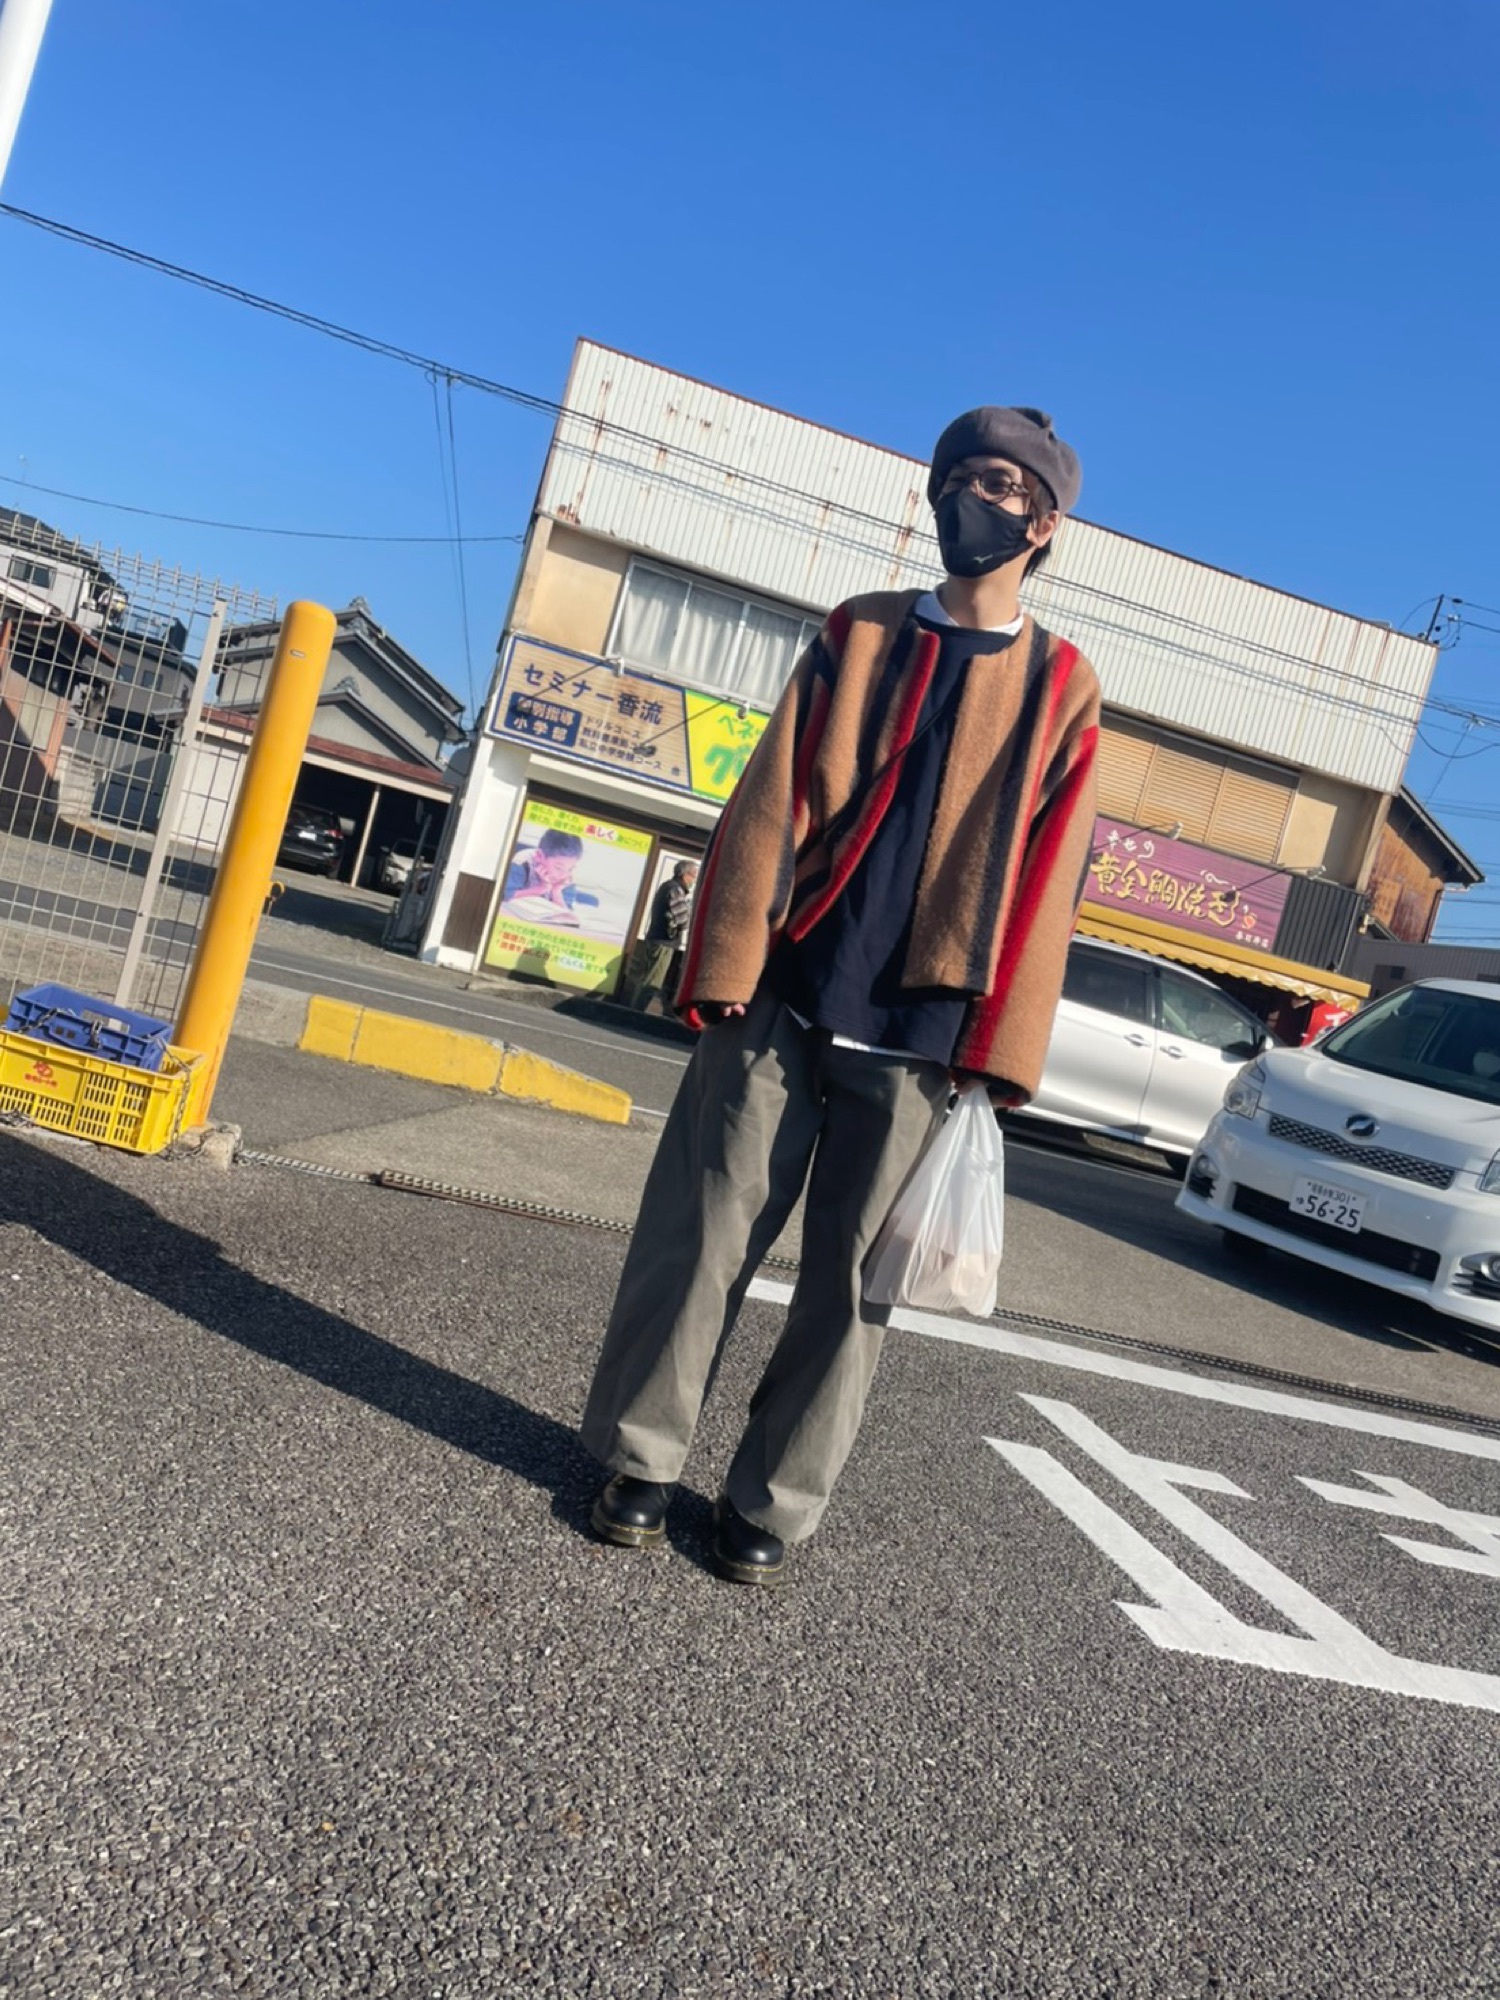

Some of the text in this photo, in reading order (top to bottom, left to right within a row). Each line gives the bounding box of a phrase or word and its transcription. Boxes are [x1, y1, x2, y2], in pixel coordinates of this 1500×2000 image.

[524, 663, 664, 726] セミナー香流
[513, 716, 568, 742] 小学部
